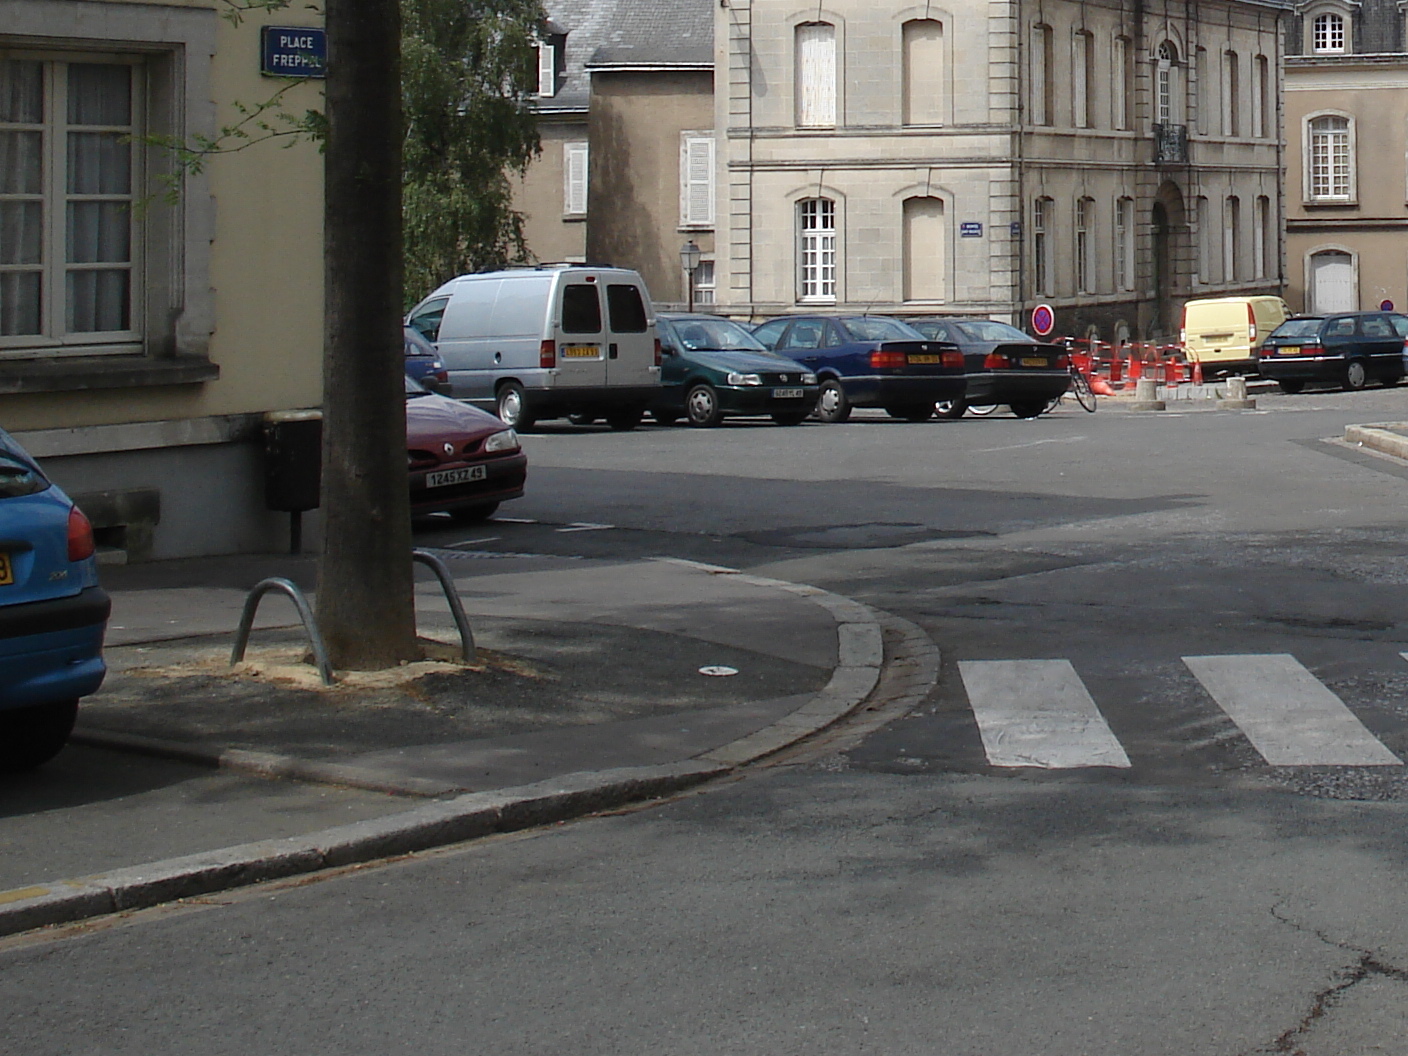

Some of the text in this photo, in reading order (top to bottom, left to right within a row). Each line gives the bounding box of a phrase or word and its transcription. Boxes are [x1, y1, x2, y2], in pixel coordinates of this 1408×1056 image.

[280, 35, 314, 49] PLACE
[431, 467, 483, 485] 1245 XZ 49
